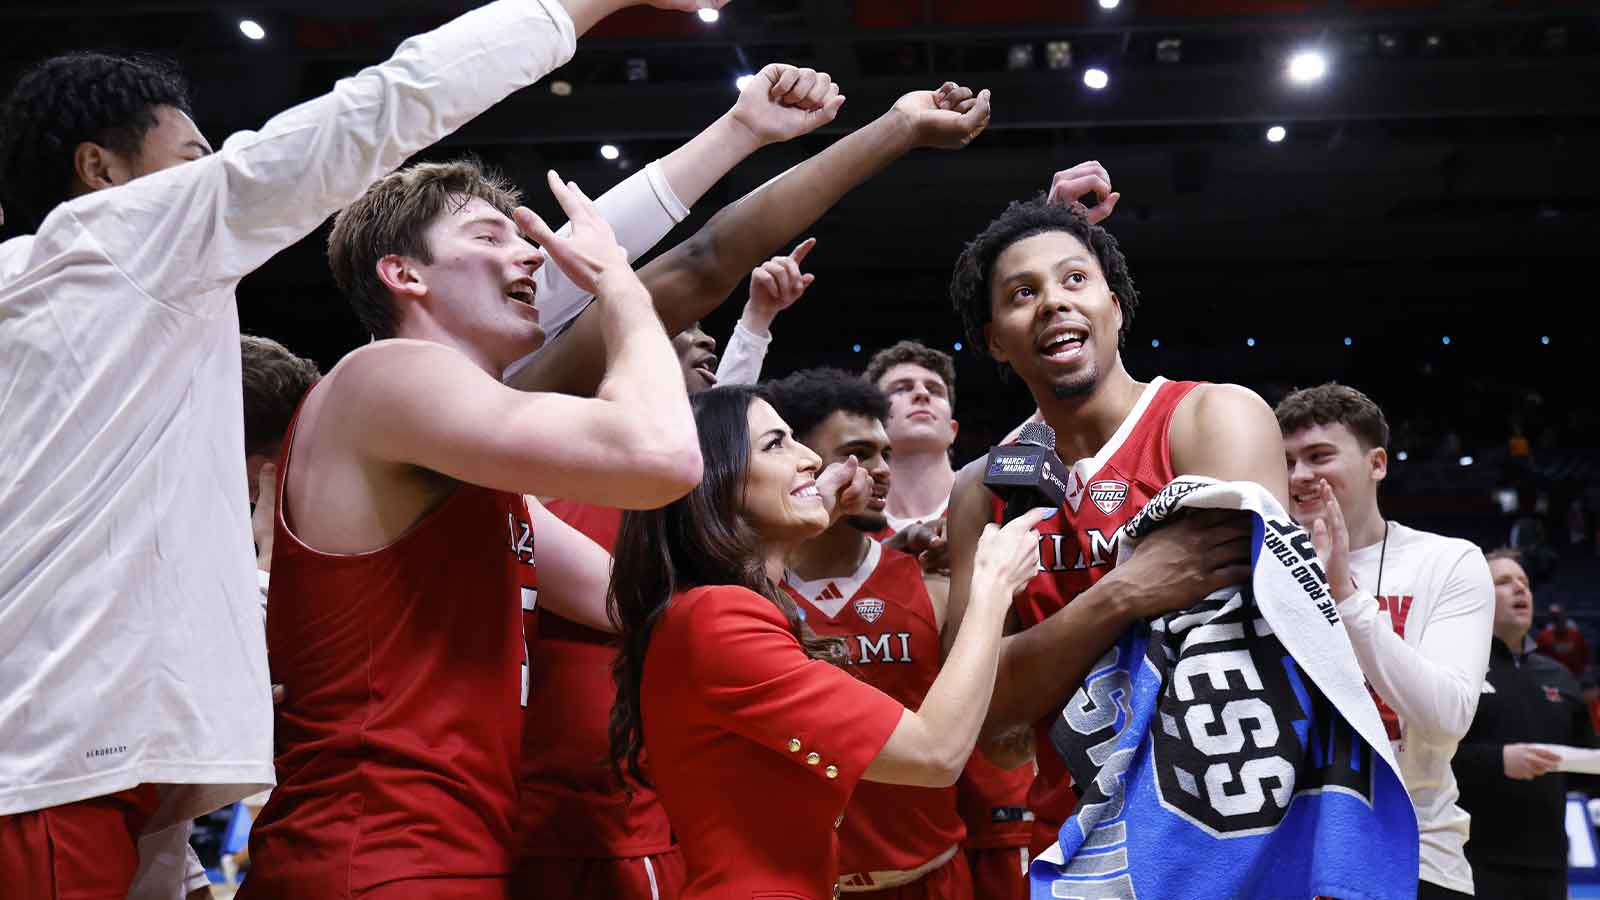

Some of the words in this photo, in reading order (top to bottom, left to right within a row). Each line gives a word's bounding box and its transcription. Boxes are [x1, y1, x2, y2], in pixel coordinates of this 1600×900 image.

[1002, 457, 1026, 465] MARCH
[1049, 473, 1066, 493] SPORTS
[1092, 491, 1125, 500] MAC
[1263, 527, 1300, 567] START
[1291, 566, 1326, 601] ROAD
[1317, 600, 1340, 627] THE
[847, 632, 912, 665] MI
